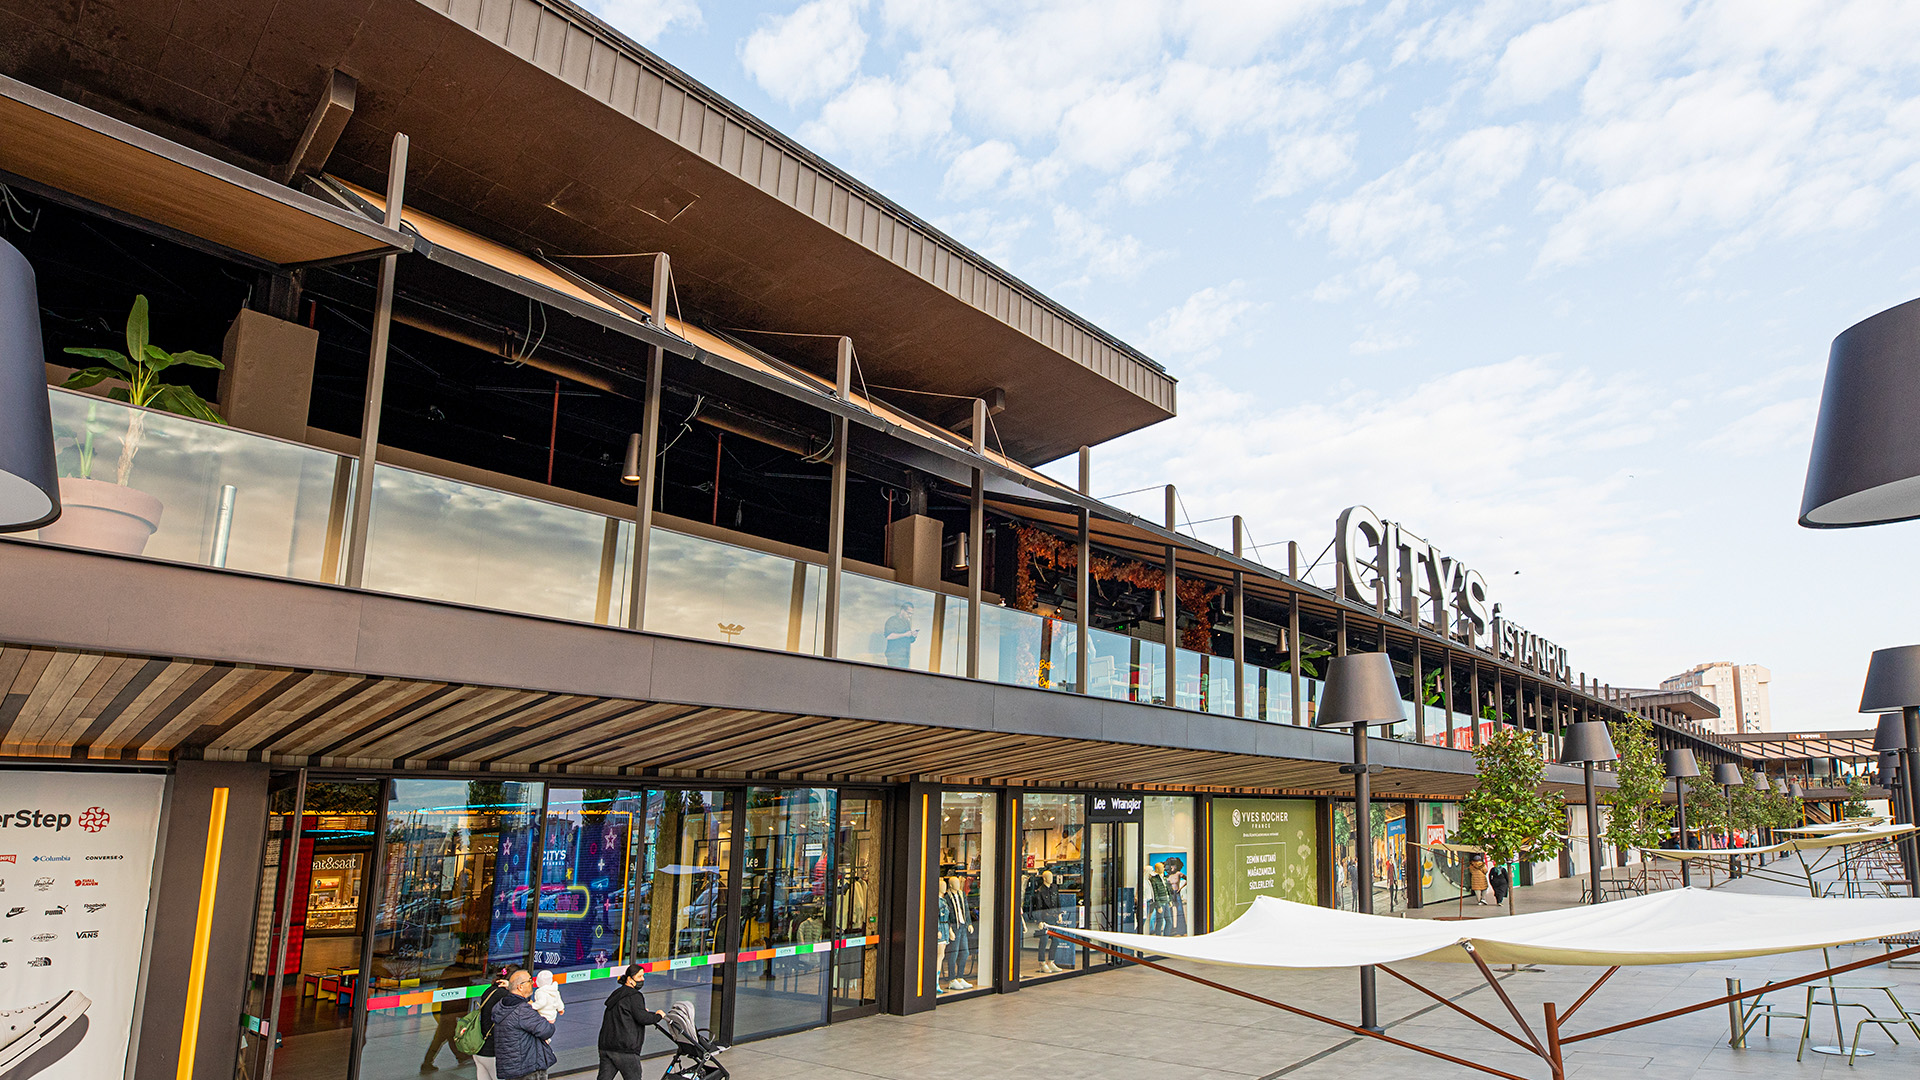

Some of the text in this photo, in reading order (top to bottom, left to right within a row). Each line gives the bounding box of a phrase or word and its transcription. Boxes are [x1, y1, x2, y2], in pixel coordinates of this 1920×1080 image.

[1336, 505, 1490, 648] CITY'S
[1491, 602, 1573, 684] İSTANBU
[1094, 797, 1141, 814] Lee Wrangler
[1242, 812, 1288, 822] YVES ROCHER
[76, 930, 99, 939] VANS
